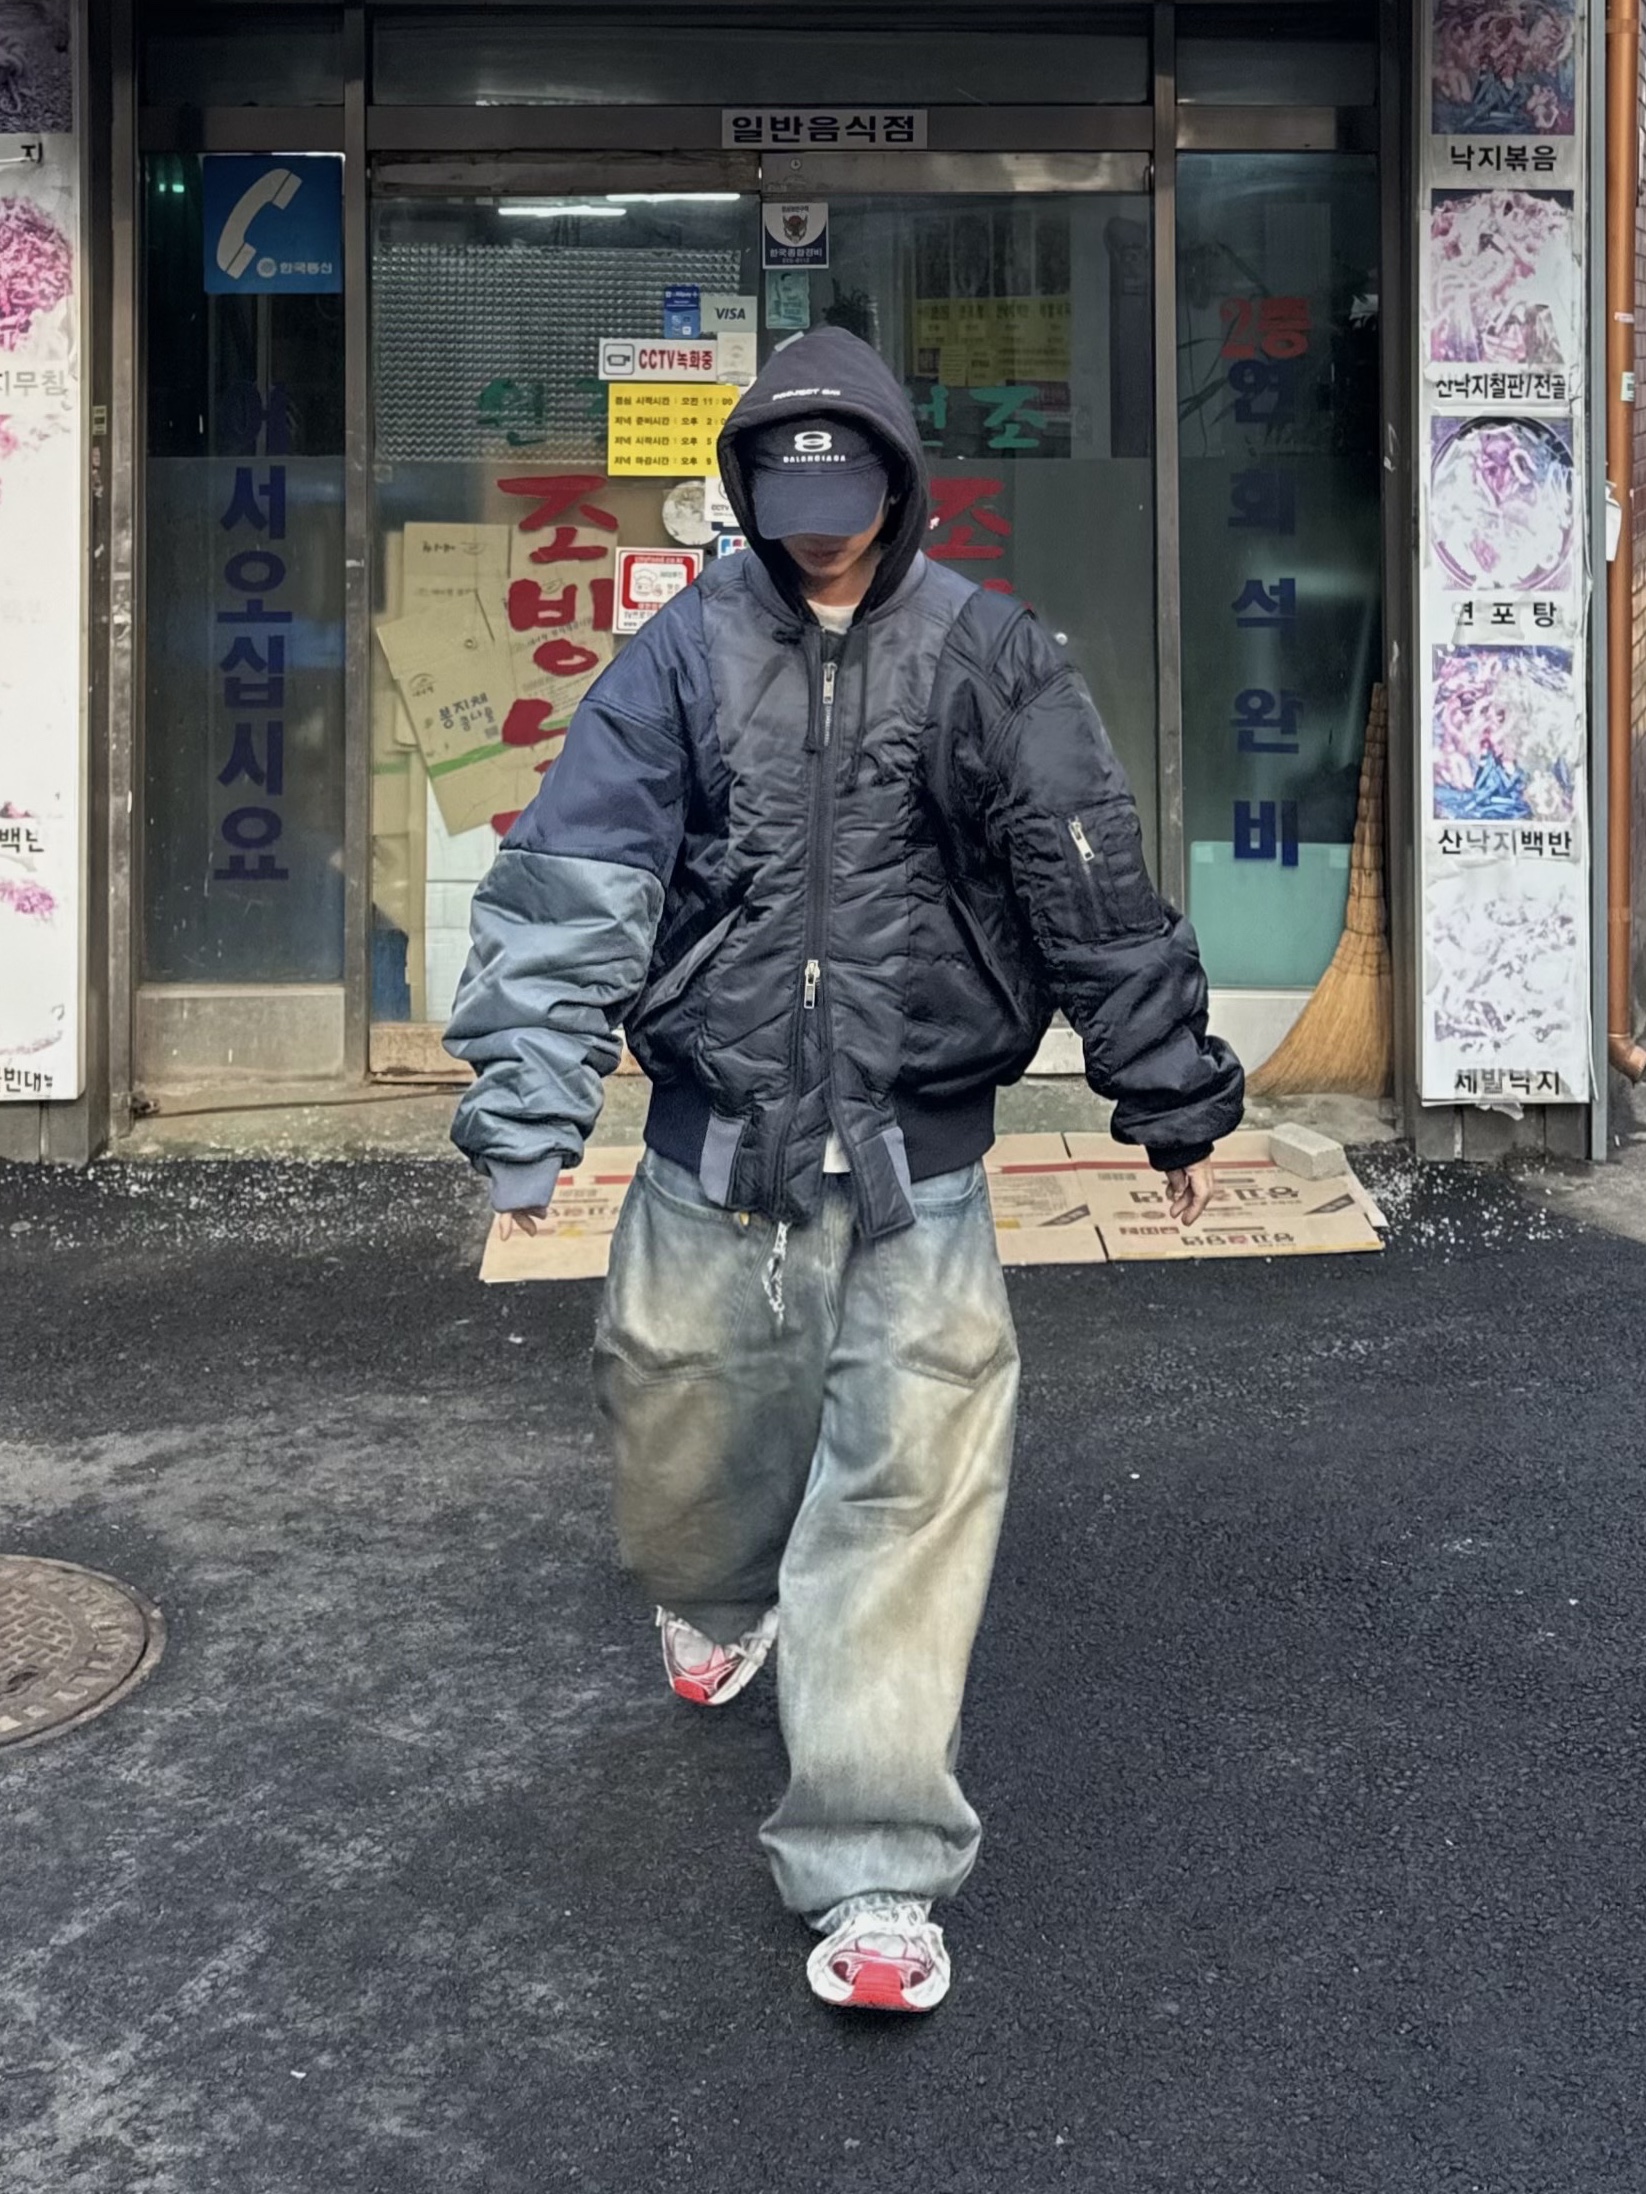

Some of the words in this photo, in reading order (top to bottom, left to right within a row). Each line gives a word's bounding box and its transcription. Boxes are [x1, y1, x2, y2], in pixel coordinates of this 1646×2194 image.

[731, 113, 917, 144] 일반음식점
[1450, 144, 1557, 172] 낙지볶음
[715, 307, 746, 320] VISA
[1435, 373, 1565, 400] 산낙지철판/전골
[681, 417, 698, 427] 오후
[681, 437, 698, 447] 오후
[681, 456, 698, 466] 오후
[1438, 829, 1573, 858] 산낙지백반
[1454, 1068, 1560, 1095] 세발낙지
